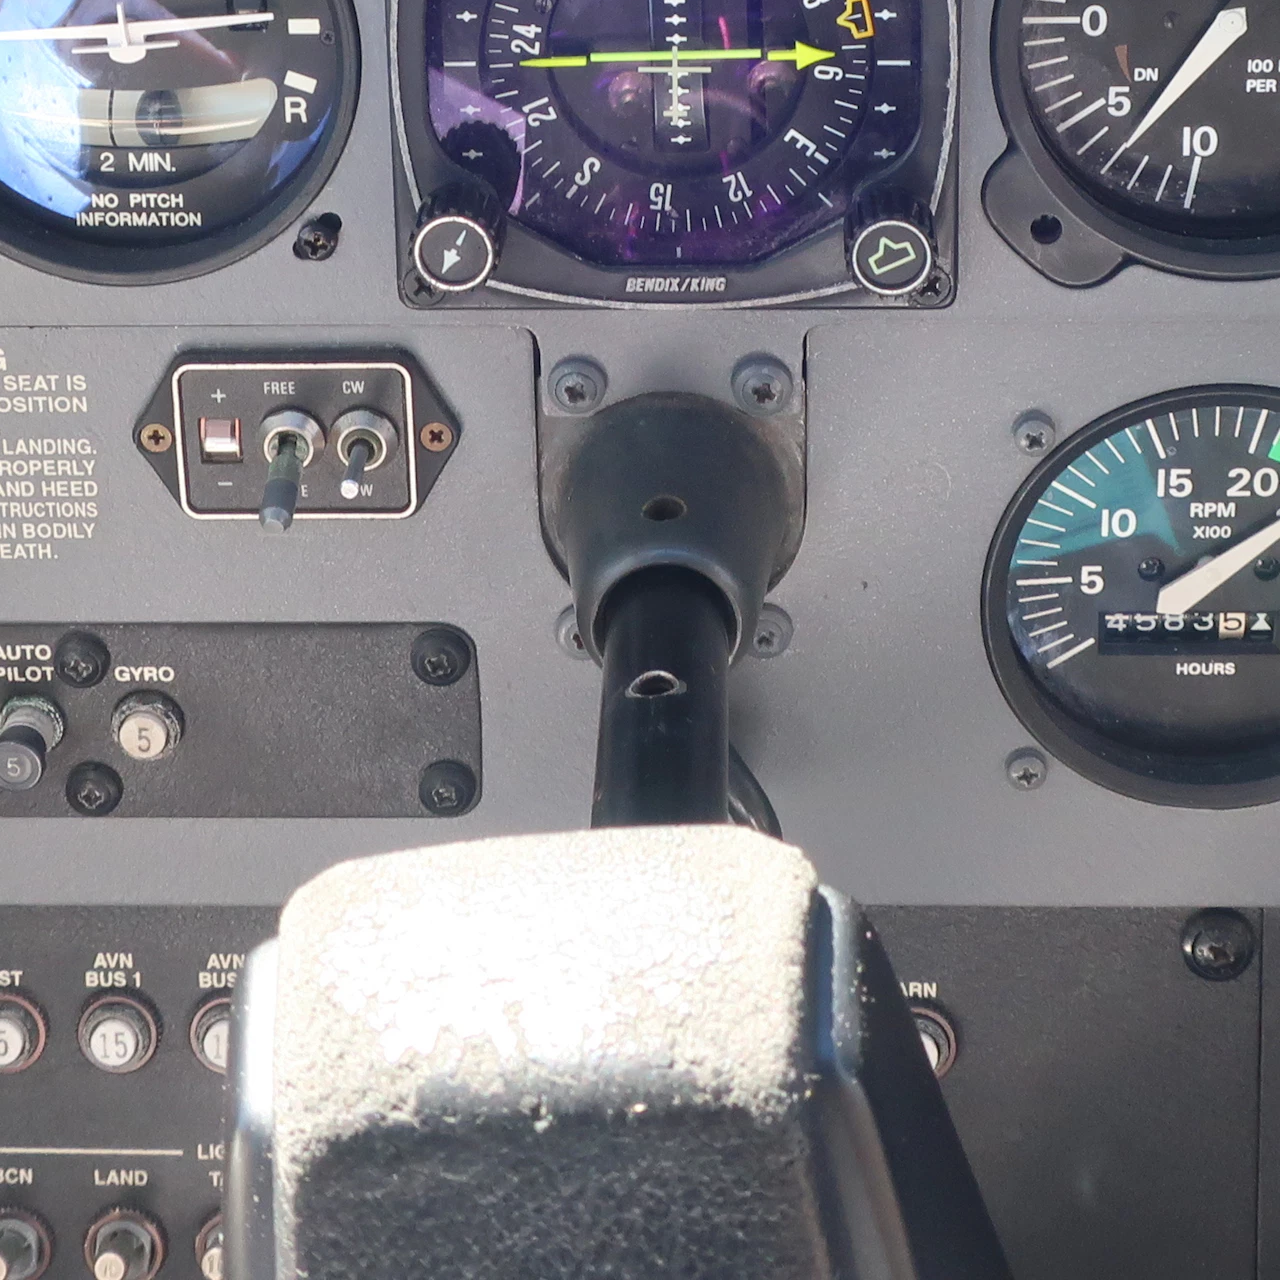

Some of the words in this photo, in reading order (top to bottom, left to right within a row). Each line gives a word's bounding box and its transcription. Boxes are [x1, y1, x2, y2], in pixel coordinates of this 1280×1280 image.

[1248, 59, 1273, 73] 100
[1134, 68, 1158, 81] DN
[1246, 79, 1277, 92] PER
[100, 152, 114, 171] 2
[128, 152, 175, 171] MIN.
[92, 194, 118, 208] NO
[130, 193, 183, 208] PITCH
[76, 212, 201, 226] INFORMATION
[626, 277, 726, 292] BENDIX/KING
[264, 382, 295, 394] FREE
[343, 381, 364, 394] CW
[3, 439, 96, 455] LANDING.
[1190, 502, 1235, 517] RPM
[23, 523, 95, 538] BODILY
[1193, 526, 1231, 538] X100
[115, 666, 174, 682] GYRO
[1176, 663, 1235, 675] HOURS
[94, 953, 132, 968] AVN
[86, 971, 126, 987] BUS
[133, 972, 140, 987] 1
[95, 1169, 147, 1185] LAND
